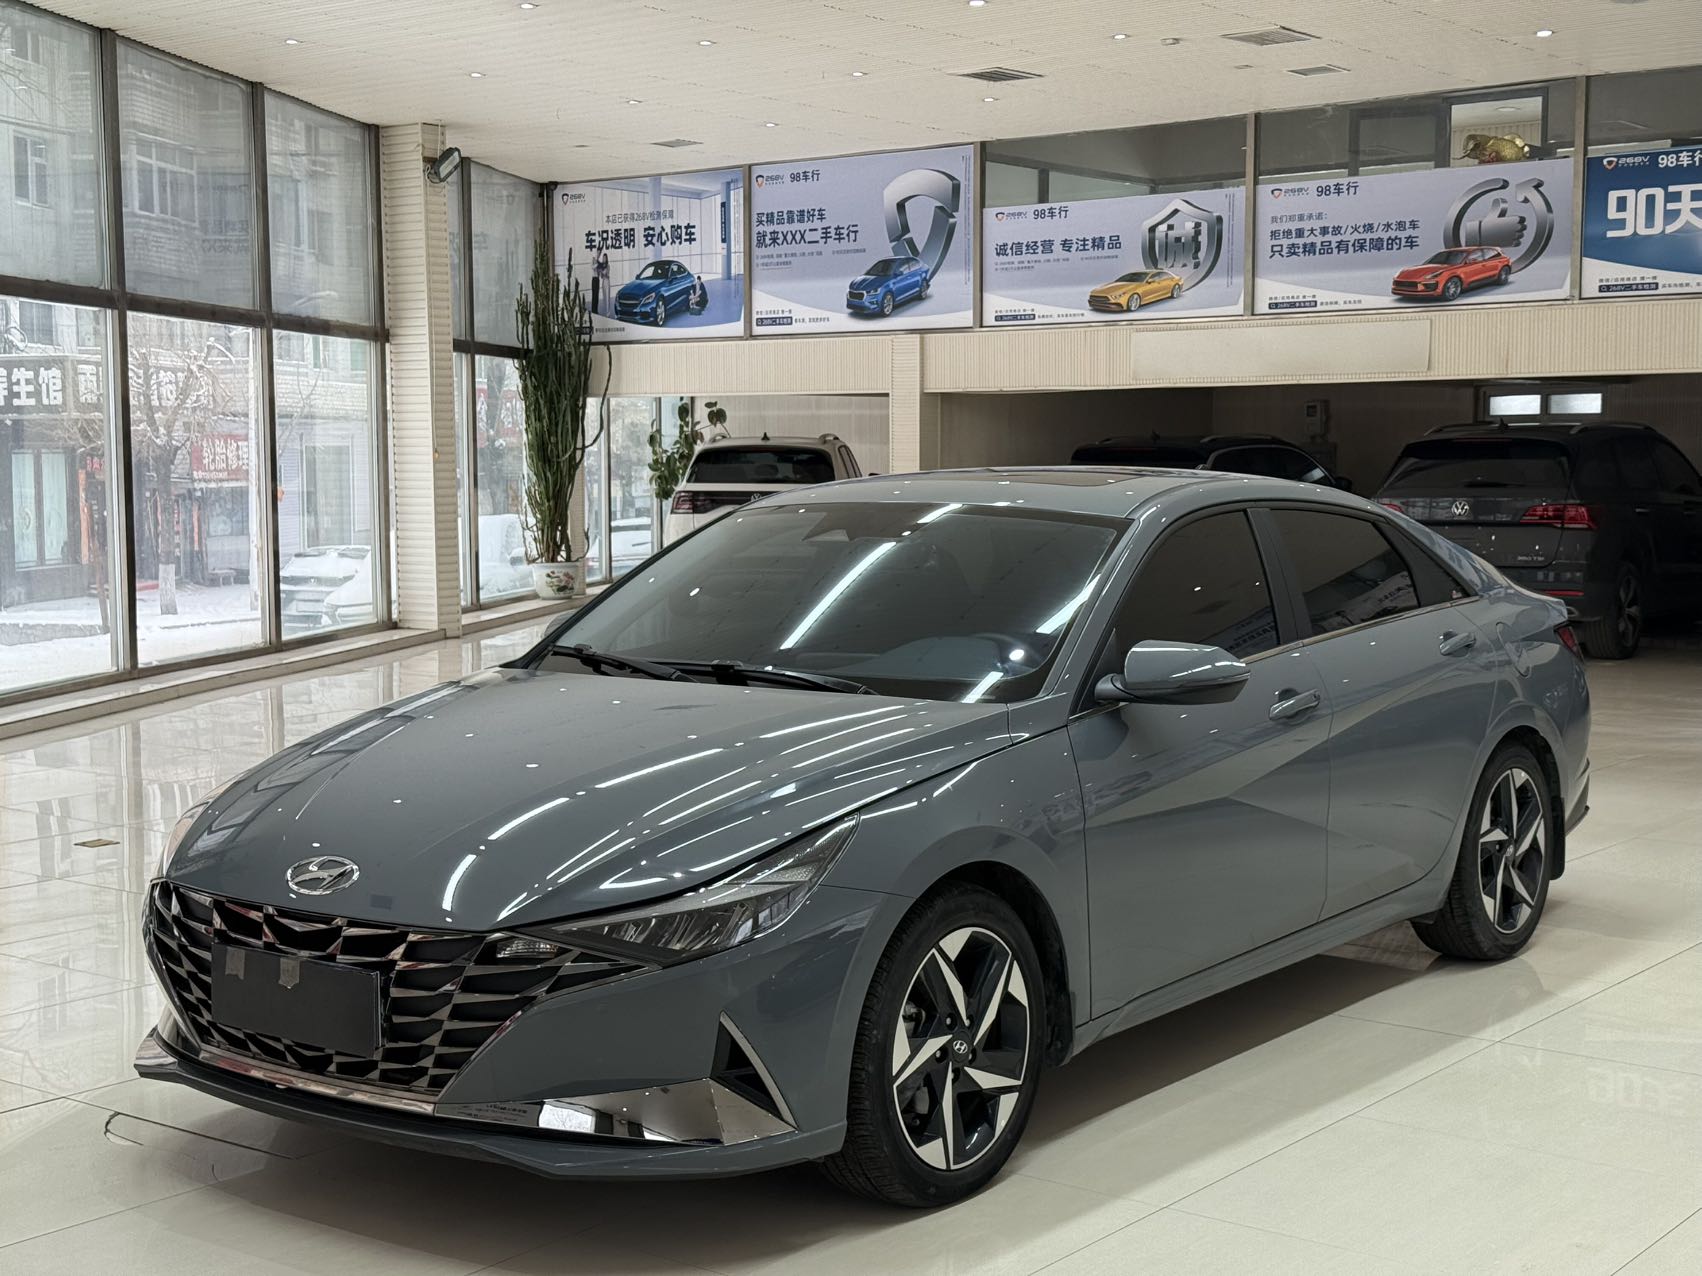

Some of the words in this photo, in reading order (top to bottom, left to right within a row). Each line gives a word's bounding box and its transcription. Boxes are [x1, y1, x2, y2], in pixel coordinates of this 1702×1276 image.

[1618, 155, 1650, 164] 268V
[789, 169, 820, 183] 98车行
[1316, 181, 1359, 197] 98车行
[755, 208, 827, 227] 买精品靠谱好车
[1033, 206, 1069, 219] 98车行
[1606, 183, 1702, 238] 90天
[585, 228, 635, 251] 车况透明
[643, 223, 696, 248] 安心购车
[755, 224, 859, 248] 就来XXX二手车行
[1269, 219, 1420, 241] 拒绝重大事故/火烧/水泡车
[995, 239, 1055, 257] 诚信经营
[1060, 235, 1122, 254] 专注精品
[1269, 235, 1420, 259] 只卖精品有保障的车
